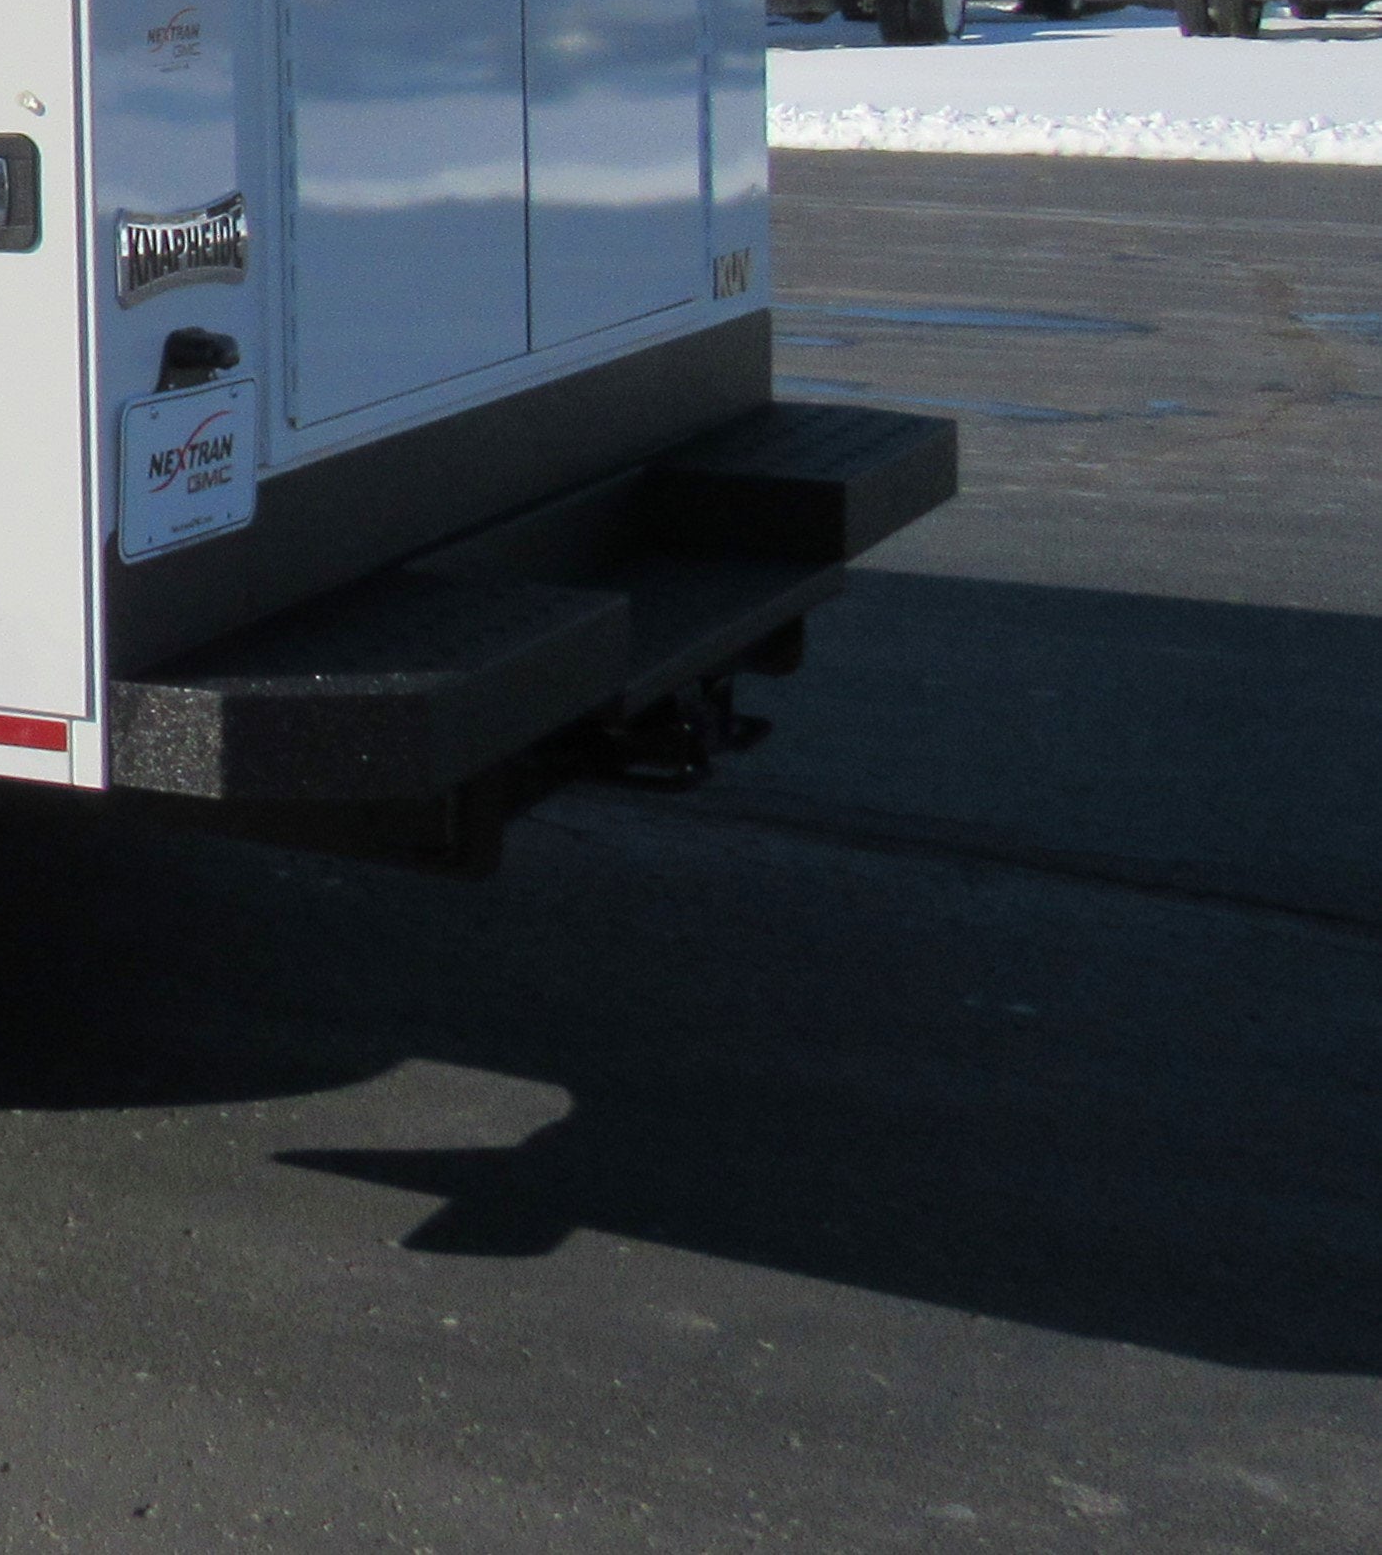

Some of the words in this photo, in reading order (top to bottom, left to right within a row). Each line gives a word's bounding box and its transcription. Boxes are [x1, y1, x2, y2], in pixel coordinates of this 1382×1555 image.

[147, 23, 201, 44] NEXTRAN
[128, 206, 245, 290] KNAPHEIDE
[149, 433, 233, 478] NEXTRAN
[187, 464, 233, 494] GMC
